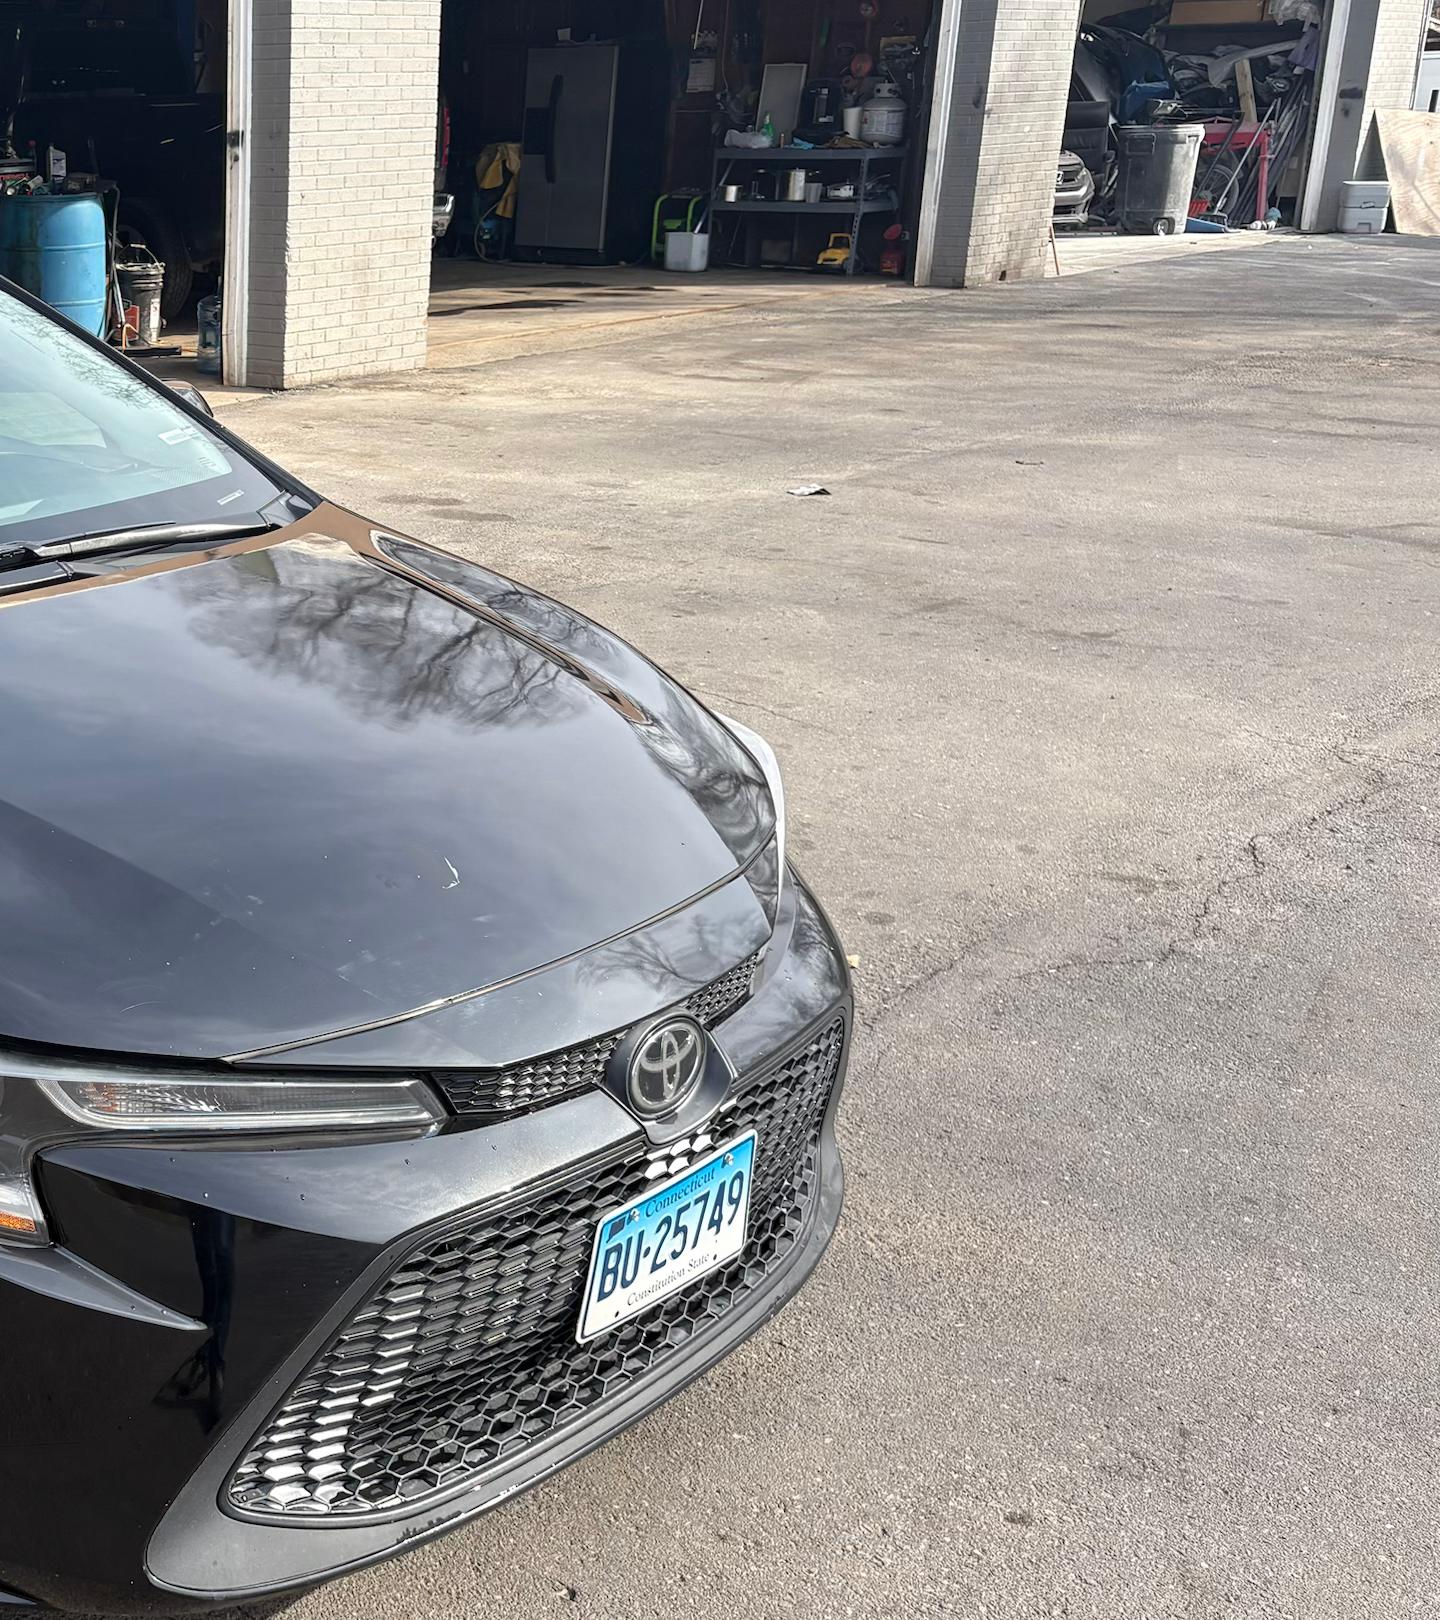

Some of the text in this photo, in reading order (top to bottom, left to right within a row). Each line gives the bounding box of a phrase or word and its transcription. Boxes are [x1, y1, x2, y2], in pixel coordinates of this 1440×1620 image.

[645, 1168, 716, 1218] Connecticut
[626, 1253, 711, 1306] Constitution State
